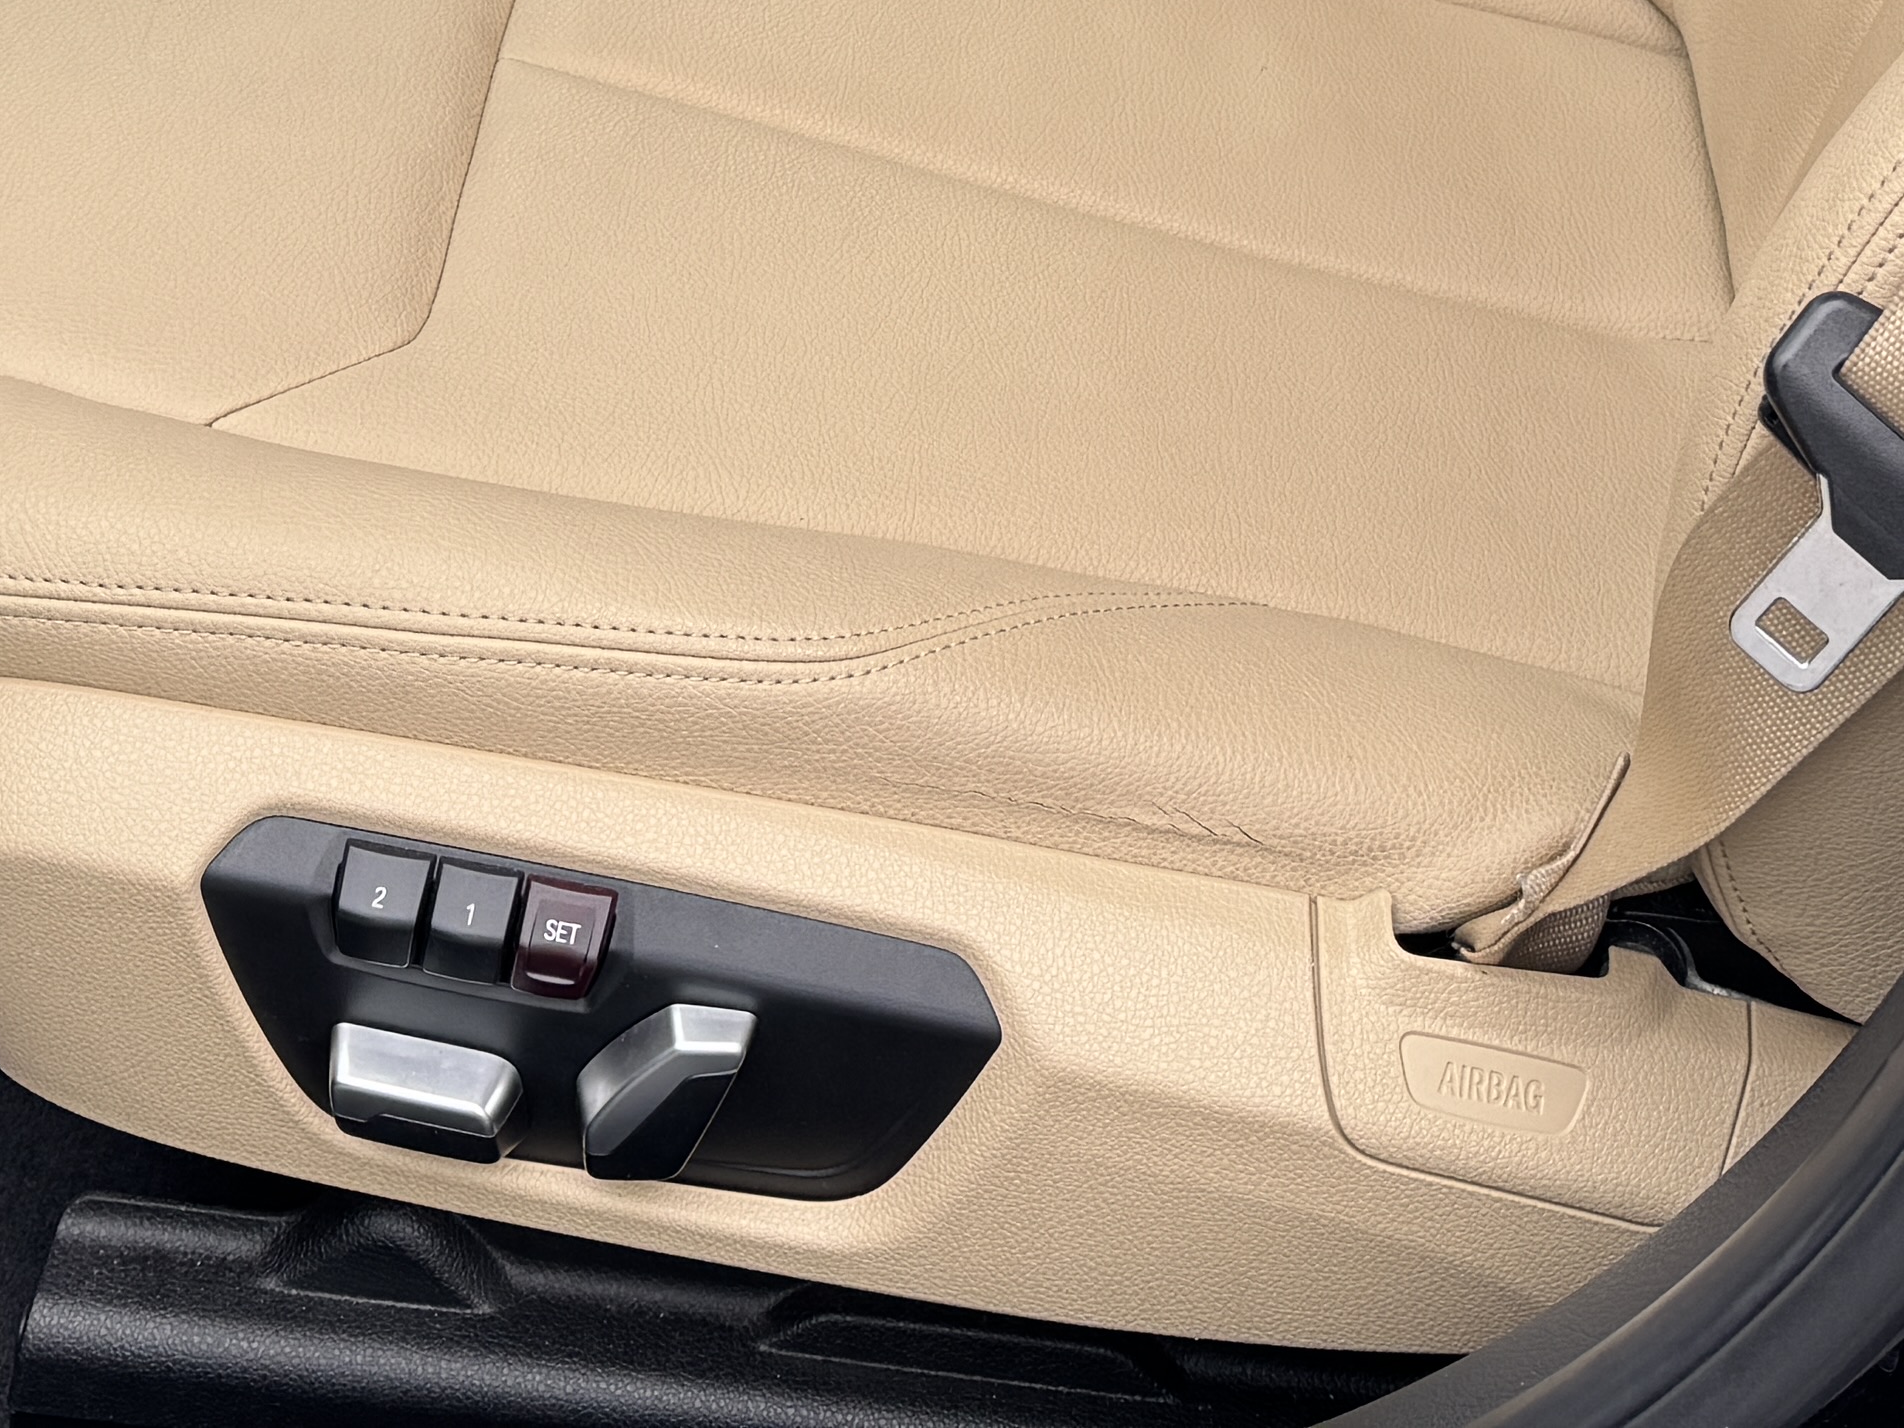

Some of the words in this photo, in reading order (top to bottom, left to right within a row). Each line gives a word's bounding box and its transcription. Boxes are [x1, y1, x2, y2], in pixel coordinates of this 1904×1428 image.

[371, 885, 386, 910] 2
[465, 901, 476, 927] 1
[542, 917, 583, 949] SET
[1437, 1060, 1547, 1117] AIRBAG
